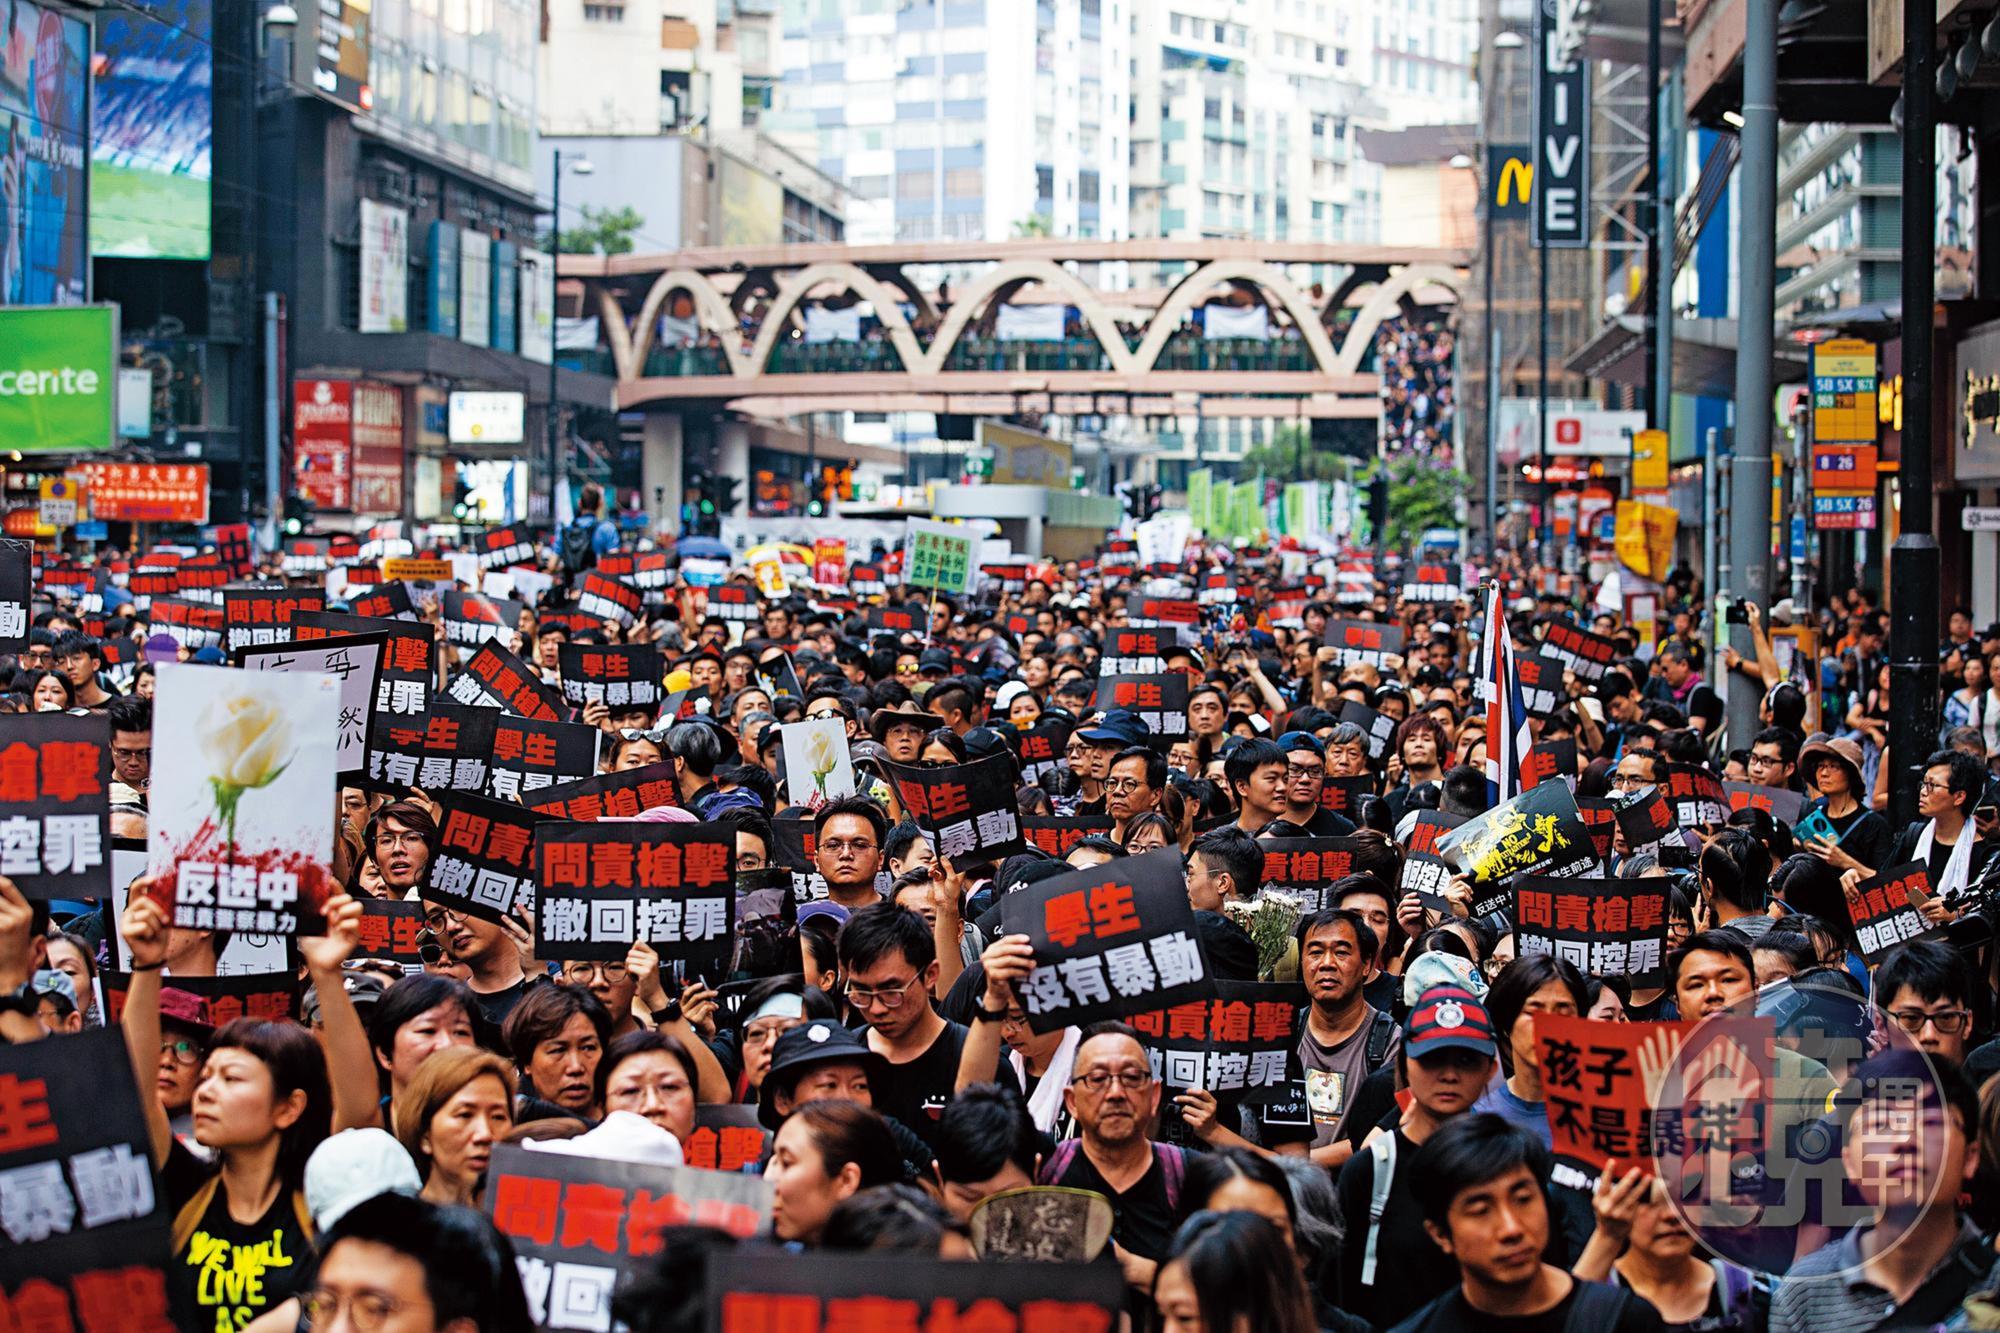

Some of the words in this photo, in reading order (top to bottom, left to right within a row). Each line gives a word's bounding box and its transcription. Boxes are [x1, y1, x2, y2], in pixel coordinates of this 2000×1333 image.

[1546, 30, 1580, 231] LIVE
[582, 653, 629, 678] 學生
[563, 679, 656, 706] 沒有暴動
[493, 727, 557, 767] 學生
[443, 809, 536, 873] 問責
[175, 860, 299, 910] 反送中
[543, 842, 730, 889] 問責槍擊
[542, 897, 728, 943] 撤回控罪
[1043, 882, 1142, 948] 學生
[1517, 889, 1664, 933] 問責槍擊
[359, 914, 423, 954] 學生
[1519, 933, 1661, 976] 撤回控罪
[1018, 930, 1206, 1016] 沒有暴動
[1542, 1036, 1632, 1096] 孩子
[187, 1231, 228, 1273] WE
[197, 1266, 267, 1306] LIVE
